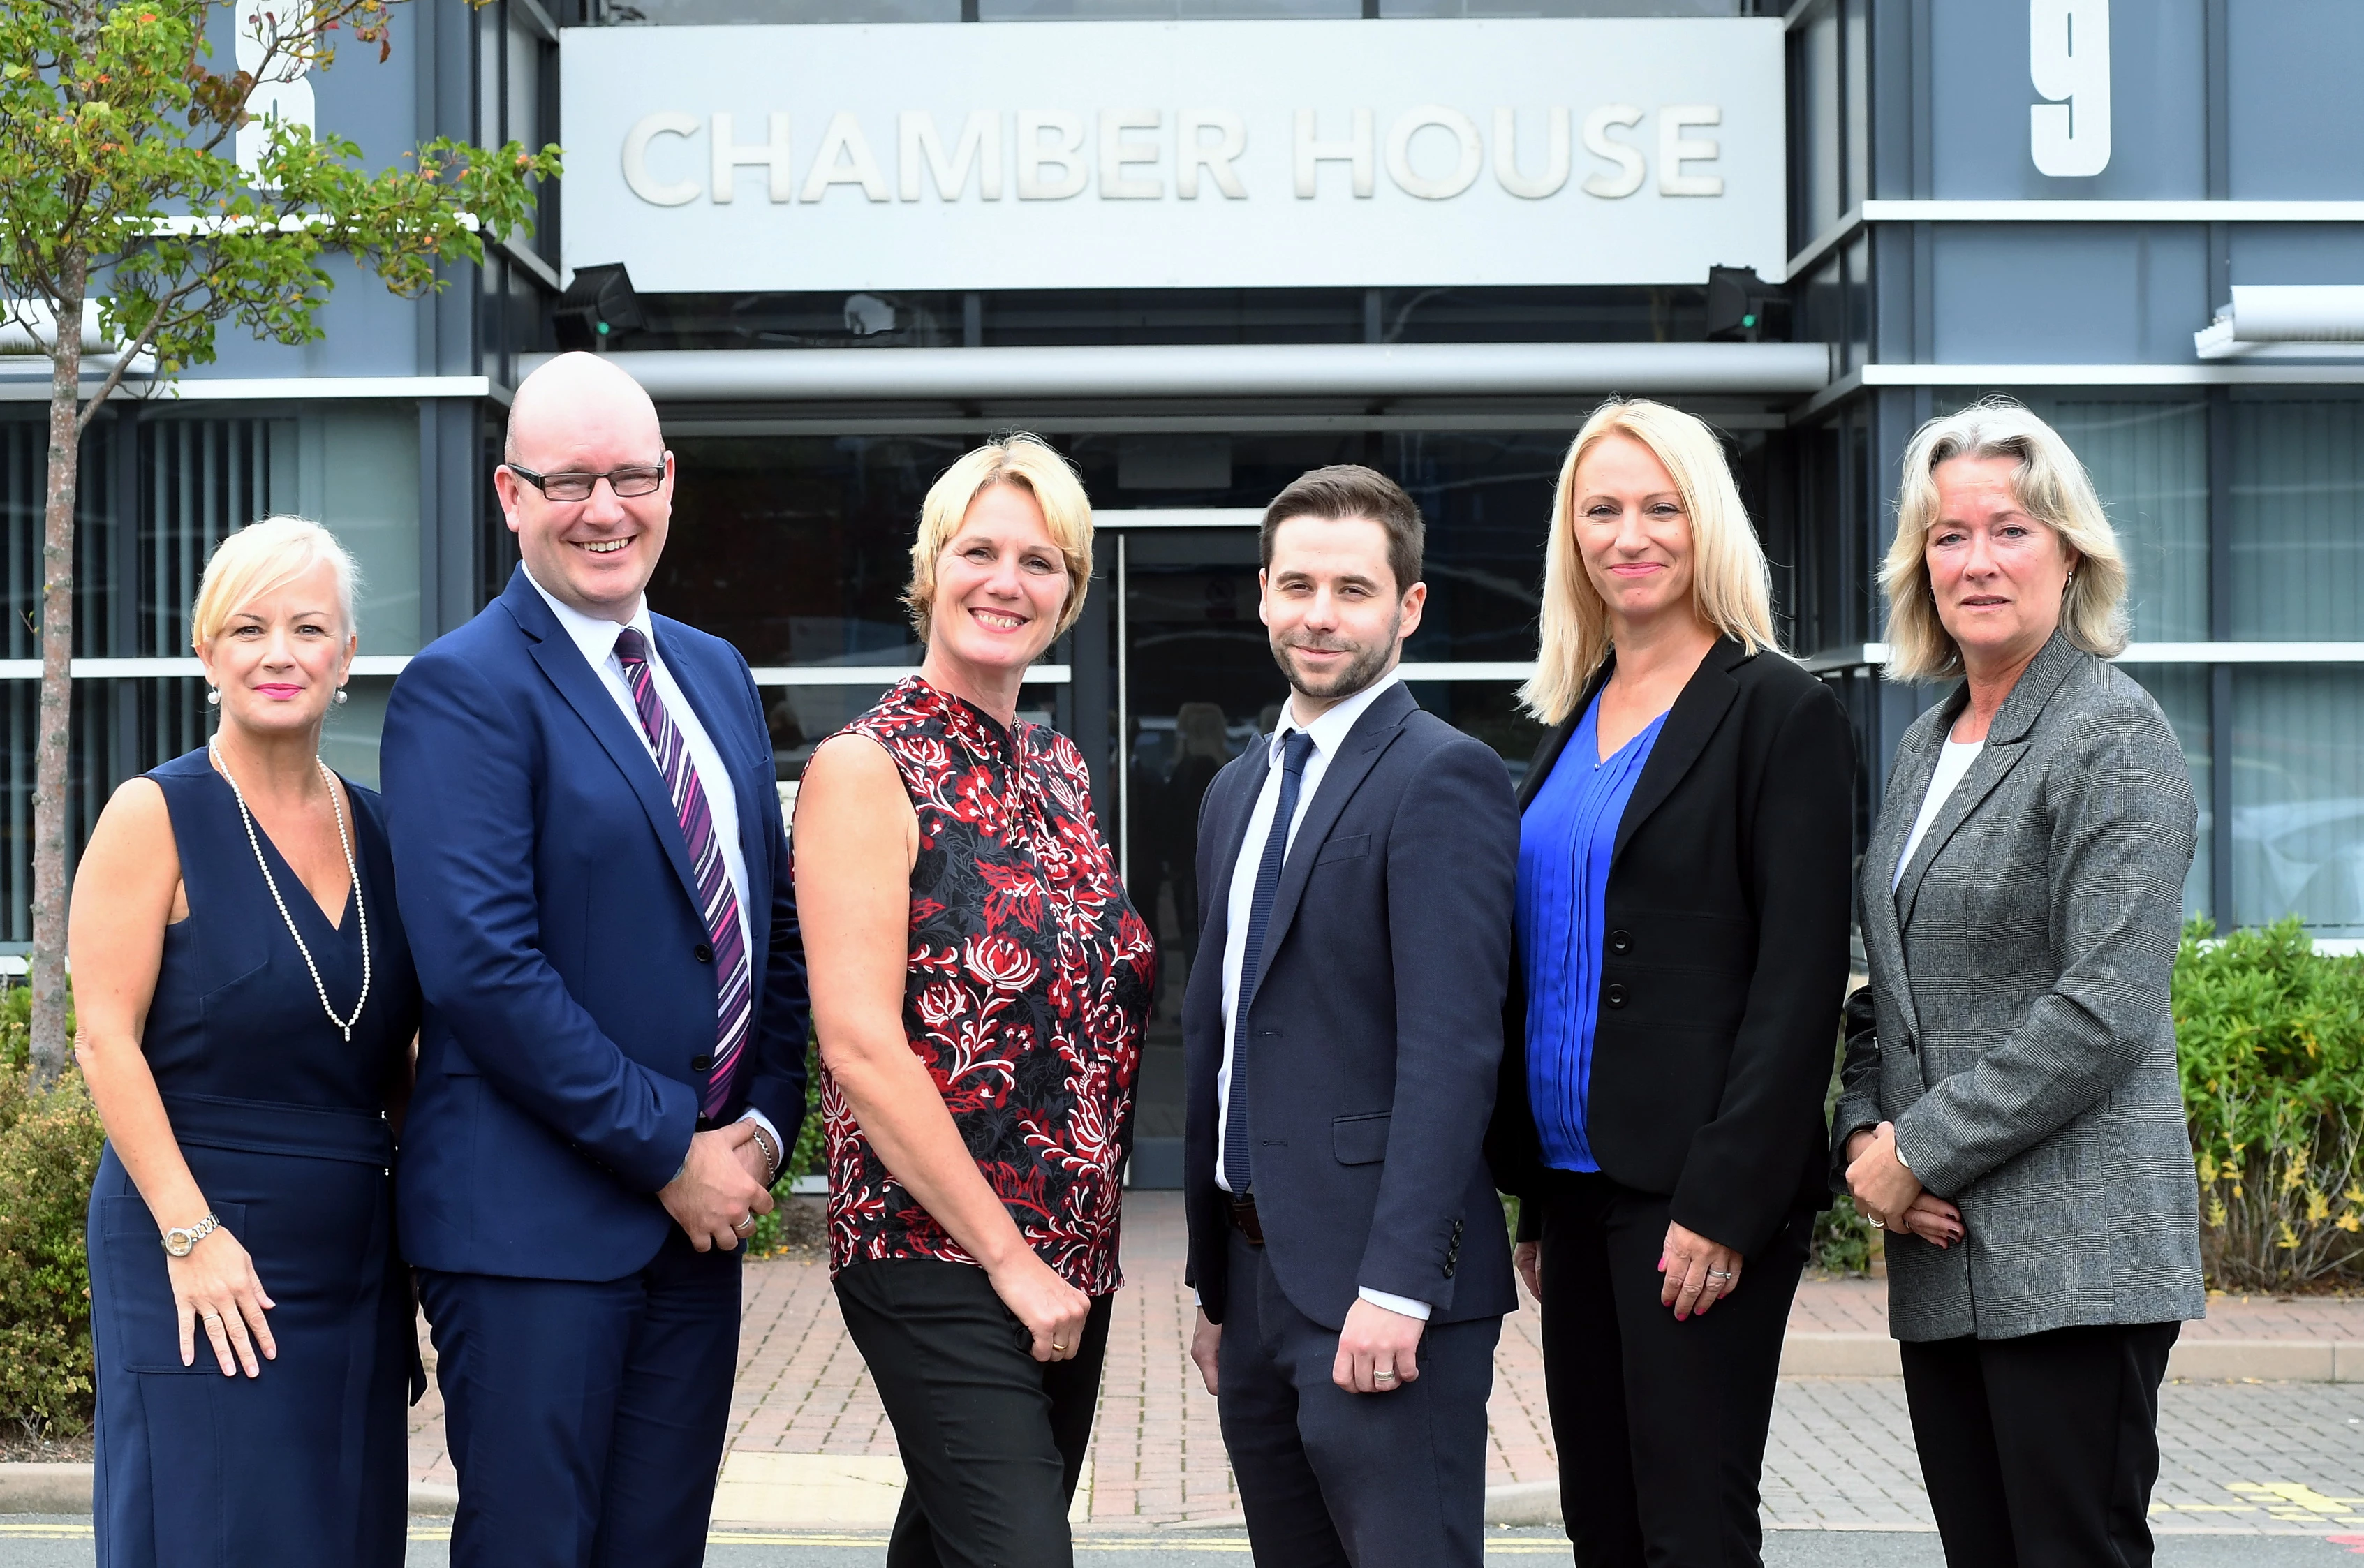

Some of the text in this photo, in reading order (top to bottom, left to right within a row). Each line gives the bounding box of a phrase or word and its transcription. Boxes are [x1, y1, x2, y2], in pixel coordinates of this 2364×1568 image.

[235, 0, 316, 191] 8
[621, 103, 1724, 207] CHAMBER HOUSE
[2030, 0, 2111, 177] 9
